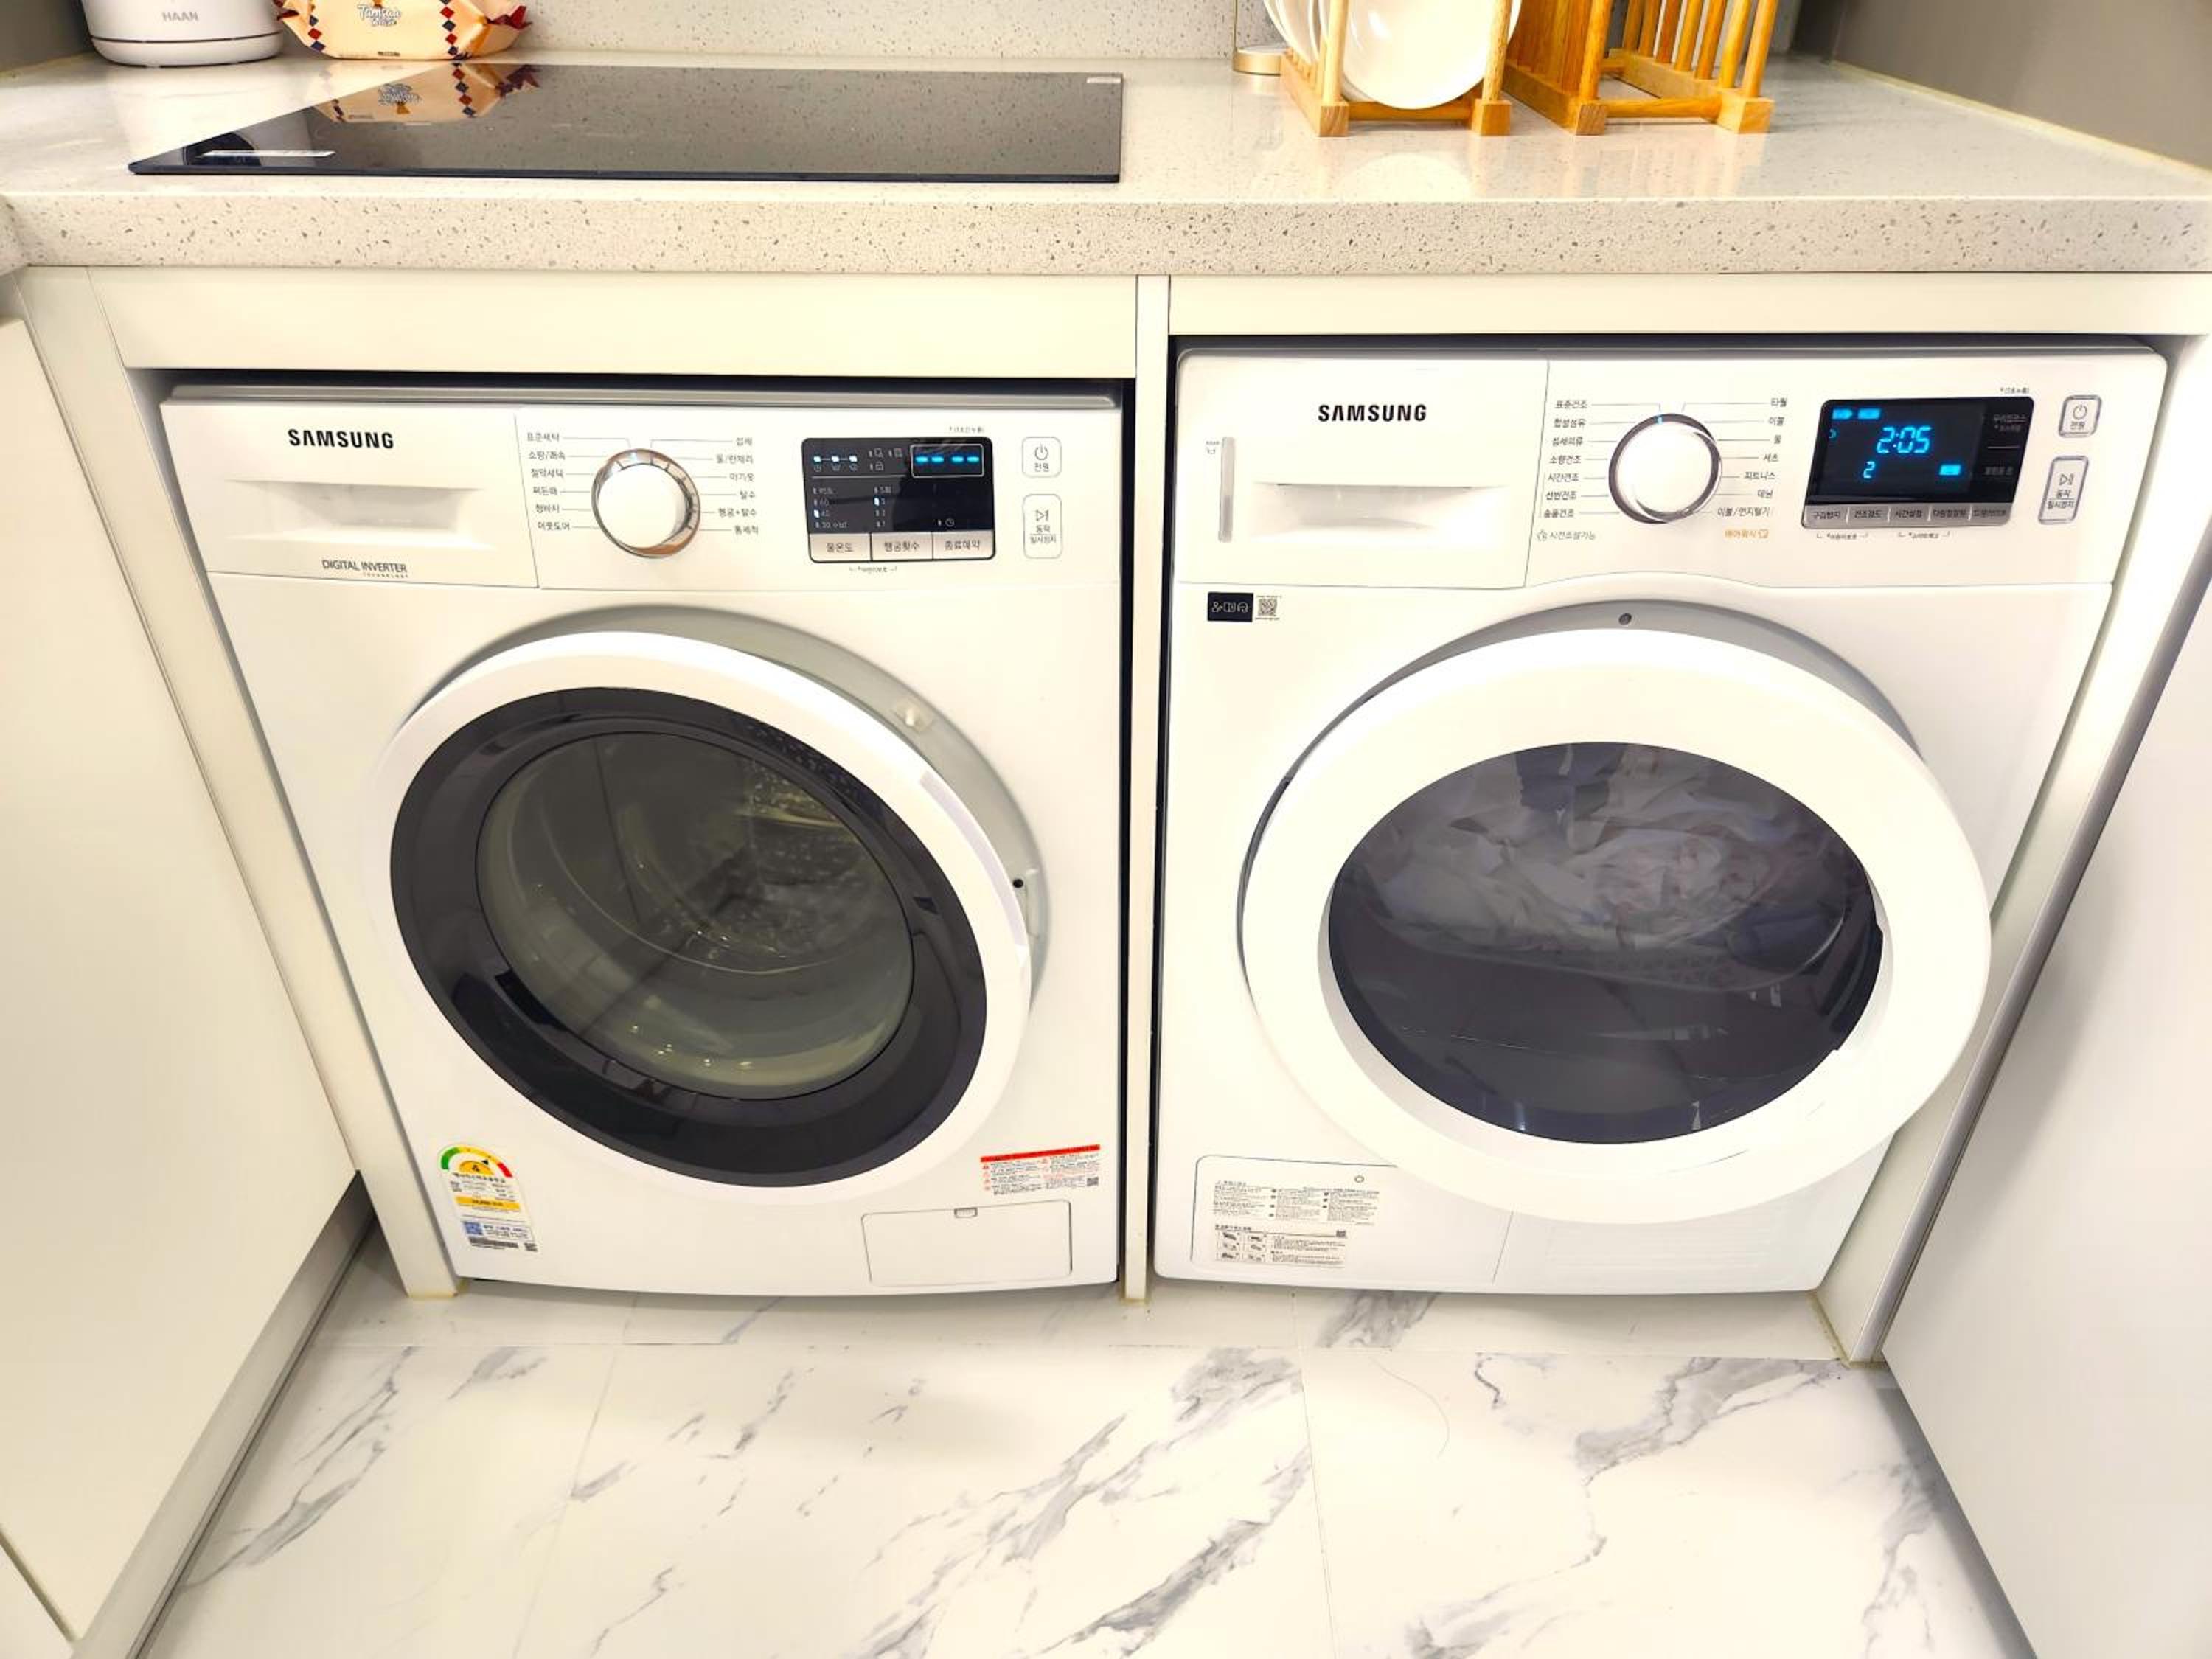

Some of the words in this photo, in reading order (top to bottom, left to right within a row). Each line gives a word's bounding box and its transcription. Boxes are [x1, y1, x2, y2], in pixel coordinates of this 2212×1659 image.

[162, 11, 198, 21] HAAN
[1555, 400, 1587, 409] 표준건조
[1770, 397, 1787, 407] 타월
[1318, 404, 1427, 422] SAMSUNG
[288, 428, 394, 449] SAMSUNG
[527, 433, 560, 442] 표준세탁
[1877, 425, 1932, 453] 2:05
[1549, 455, 1581, 465] 소량건조
[1034, 462, 1050, 473] 전원
[1863, 461, 1876, 479] 2
[1548, 473, 1579, 482] 시간건조
[322, 560, 361, 571] DIGITAL
[361, 562, 408, 573] INVERTER
